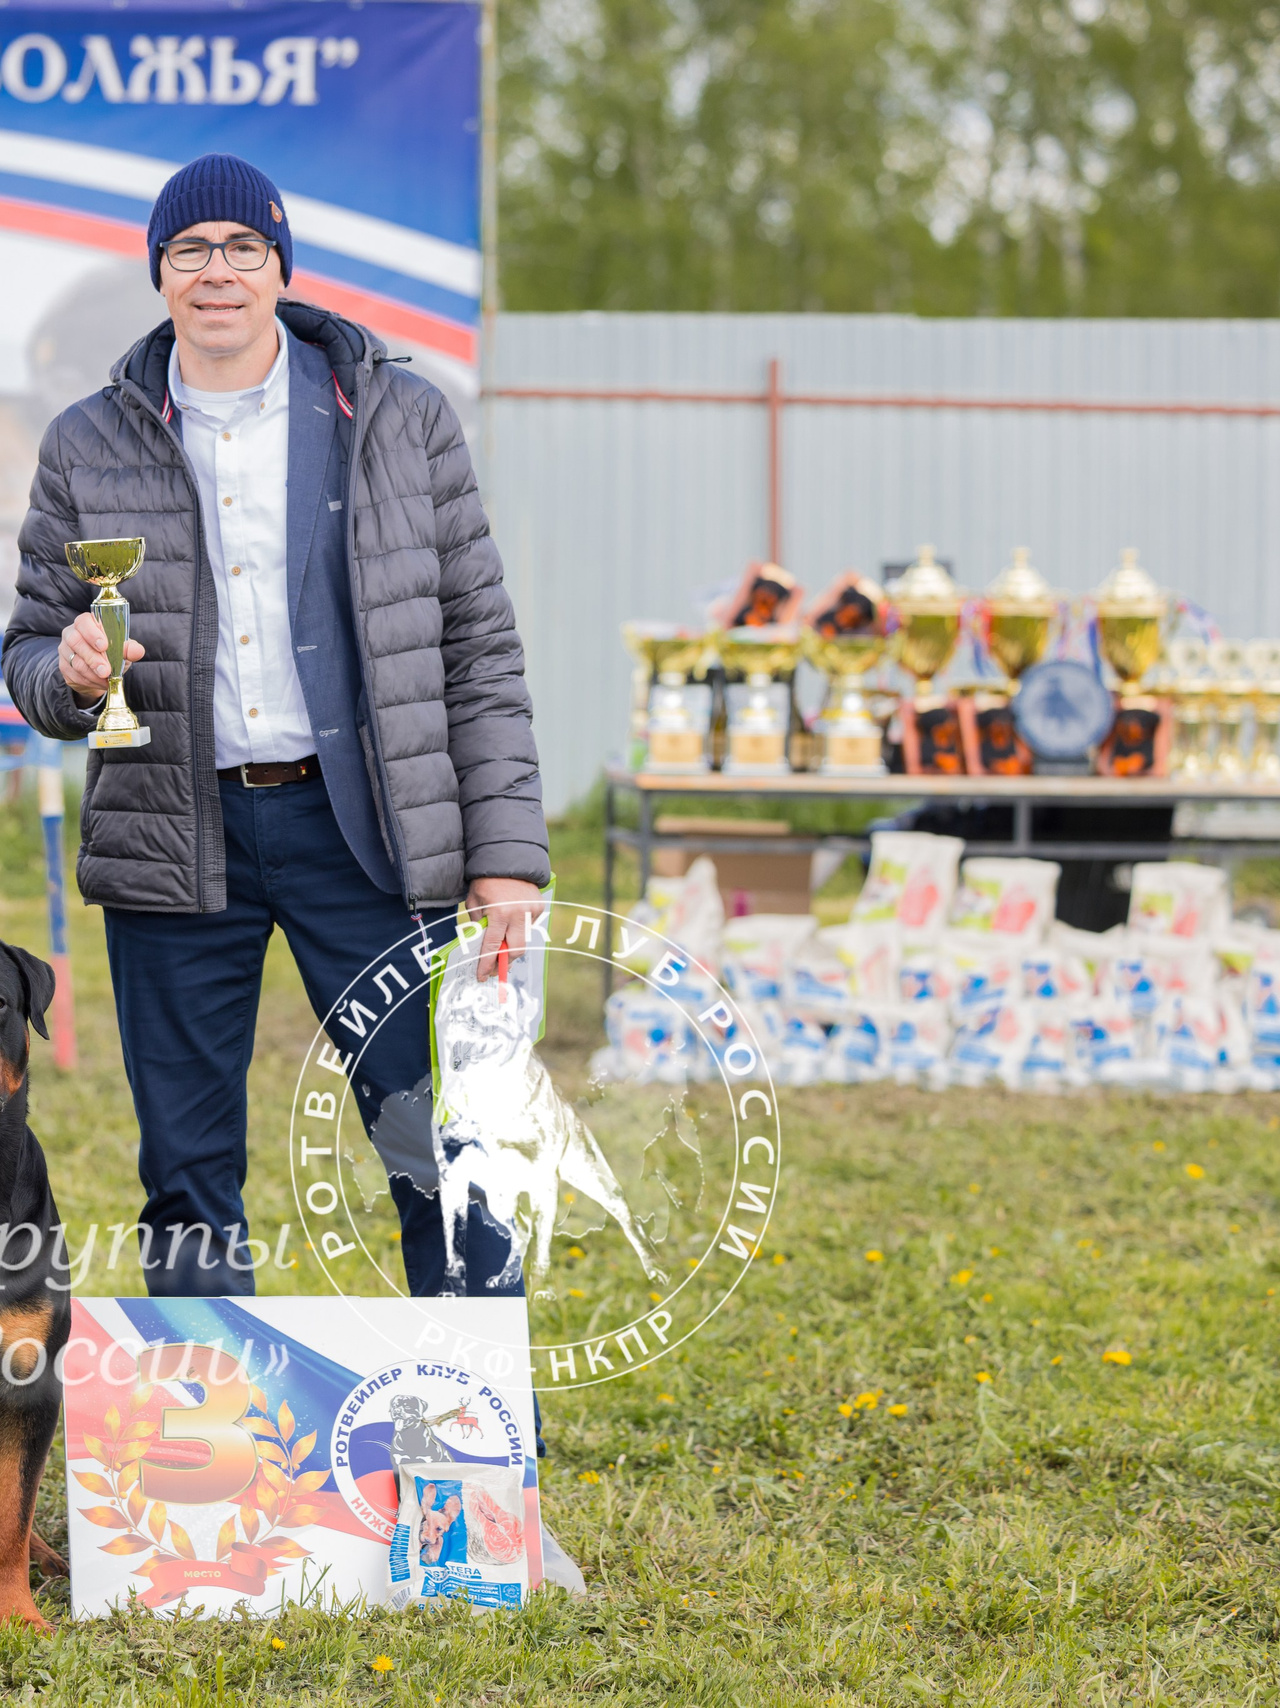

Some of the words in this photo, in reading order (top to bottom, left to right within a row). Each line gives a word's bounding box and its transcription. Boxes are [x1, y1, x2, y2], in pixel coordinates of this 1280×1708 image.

[136, 1343, 260, 1506] 3
[335, 1367, 403, 1467] РОТВЕЙЛЕР
[416, 1364, 471, 1386] КЛУБ
[478, 1386, 523, 1466] РОССИИ
